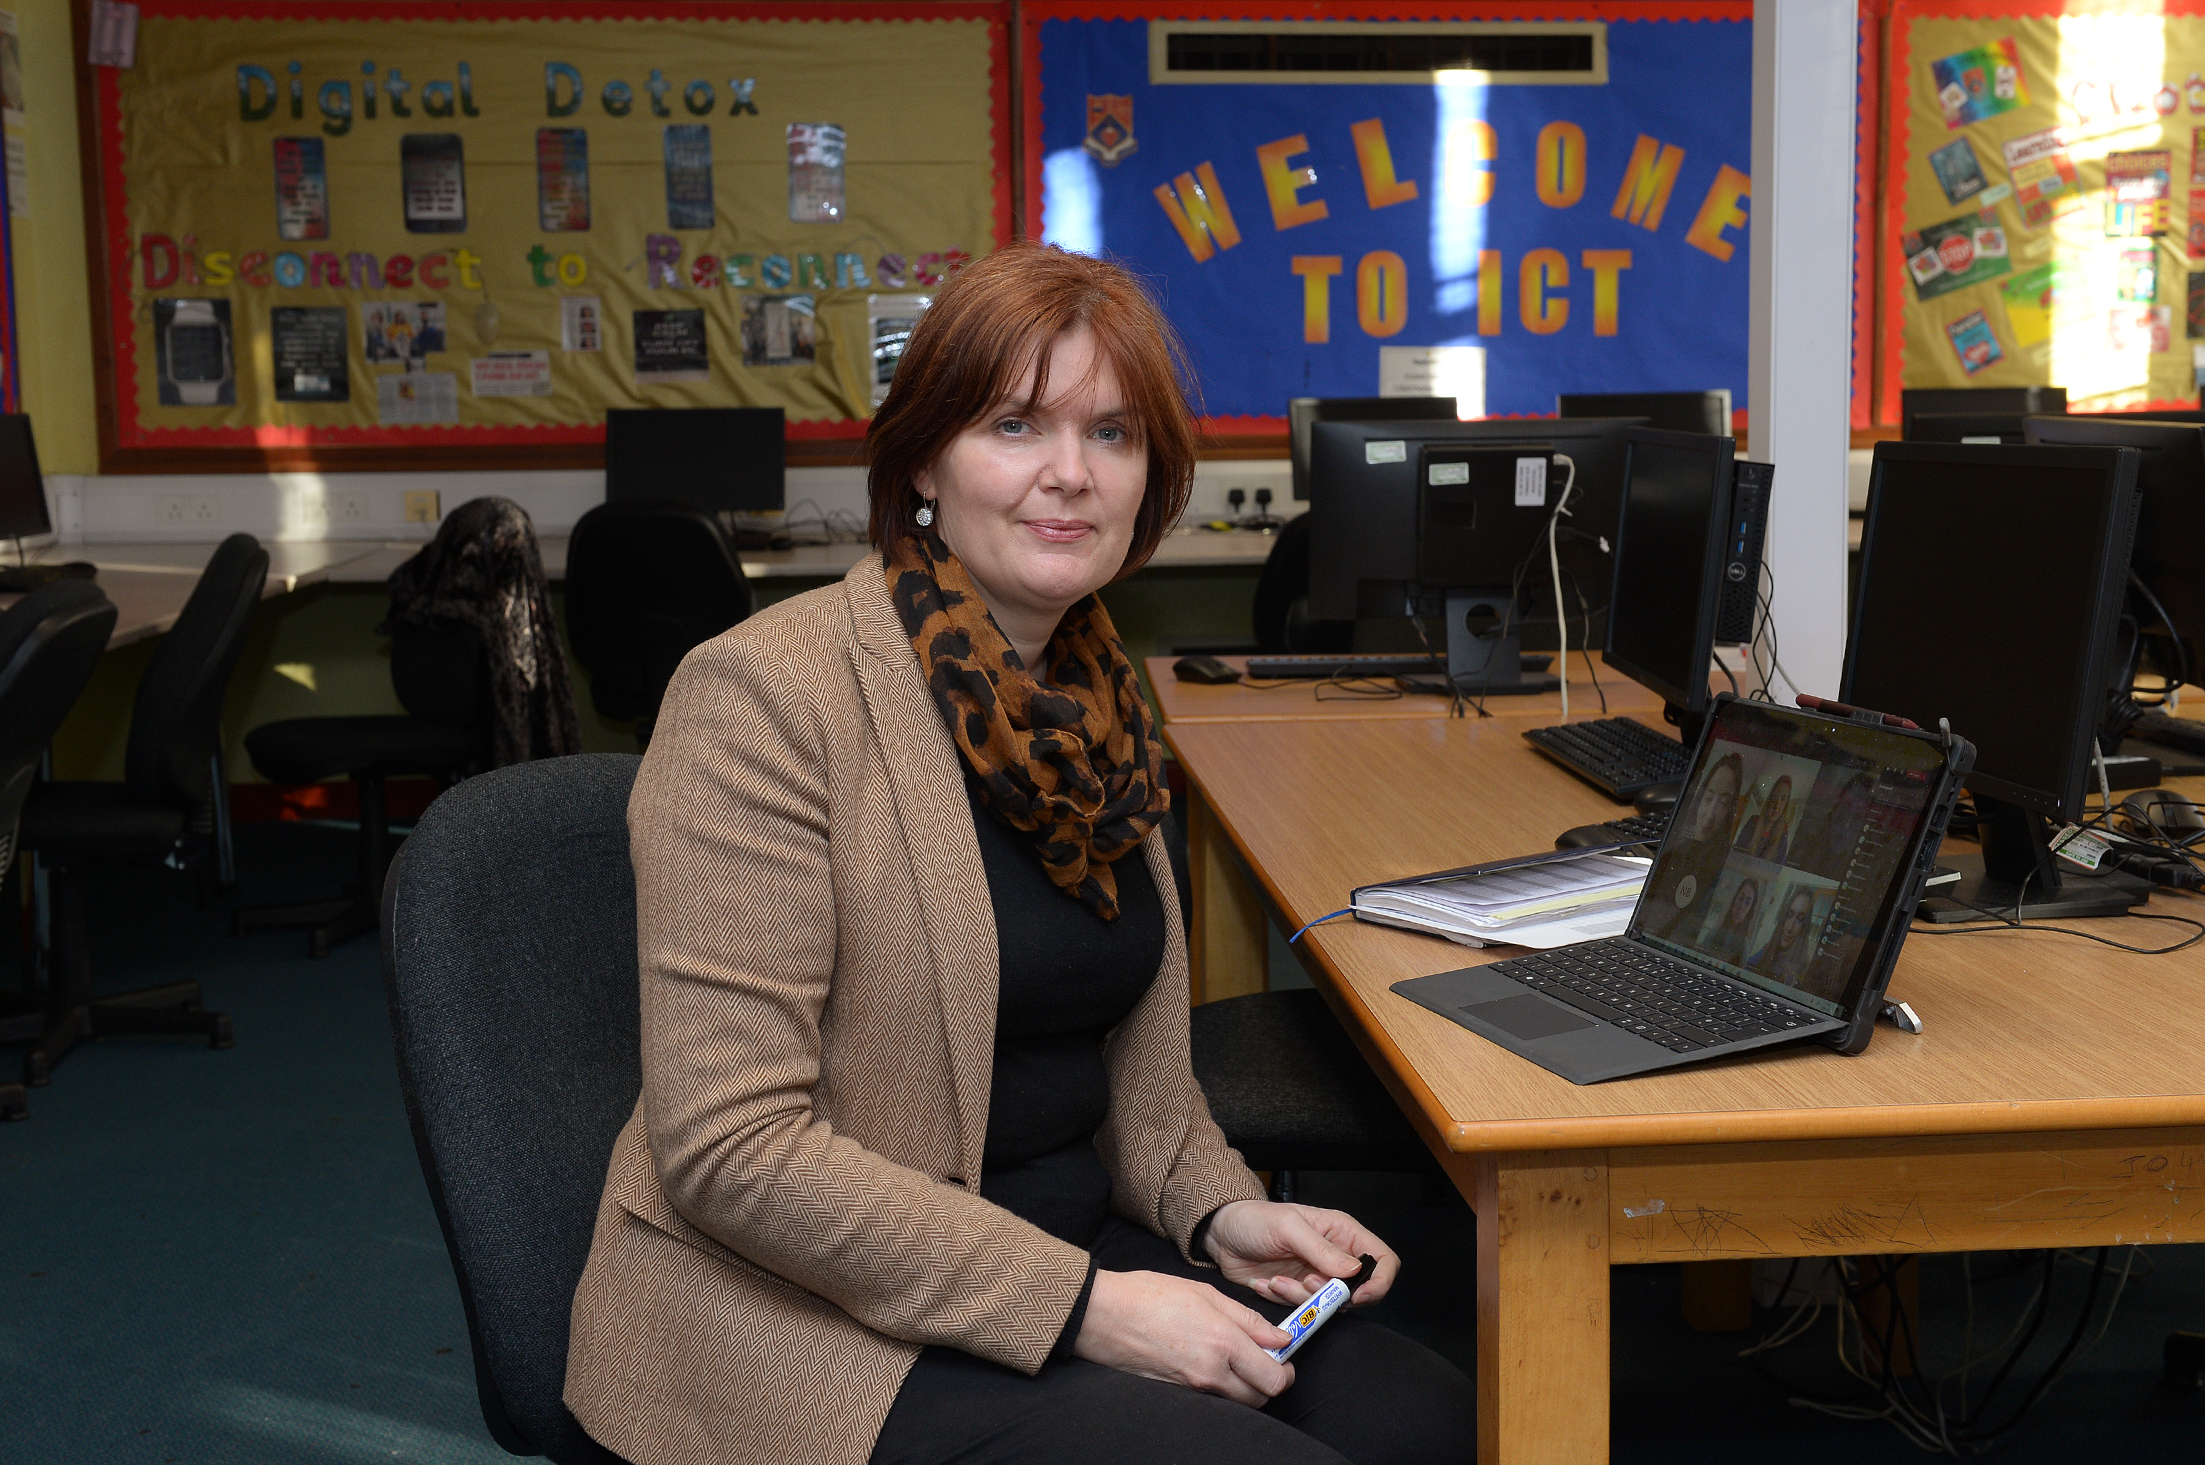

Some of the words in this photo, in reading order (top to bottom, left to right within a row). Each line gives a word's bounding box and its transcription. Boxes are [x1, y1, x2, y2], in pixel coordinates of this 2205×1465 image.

[237, 60, 480, 137] Digital
[545, 61, 759, 117] Detox
[1152, 117, 1752, 264] WELCOME
[140, 232, 483, 290] Disconnect
[527, 244, 587, 288] to
[1291, 249, 1408, 344] TO
[1477, 248, 1633, 338] ICT
[1300, 1309, 1316, 1326] BIC
